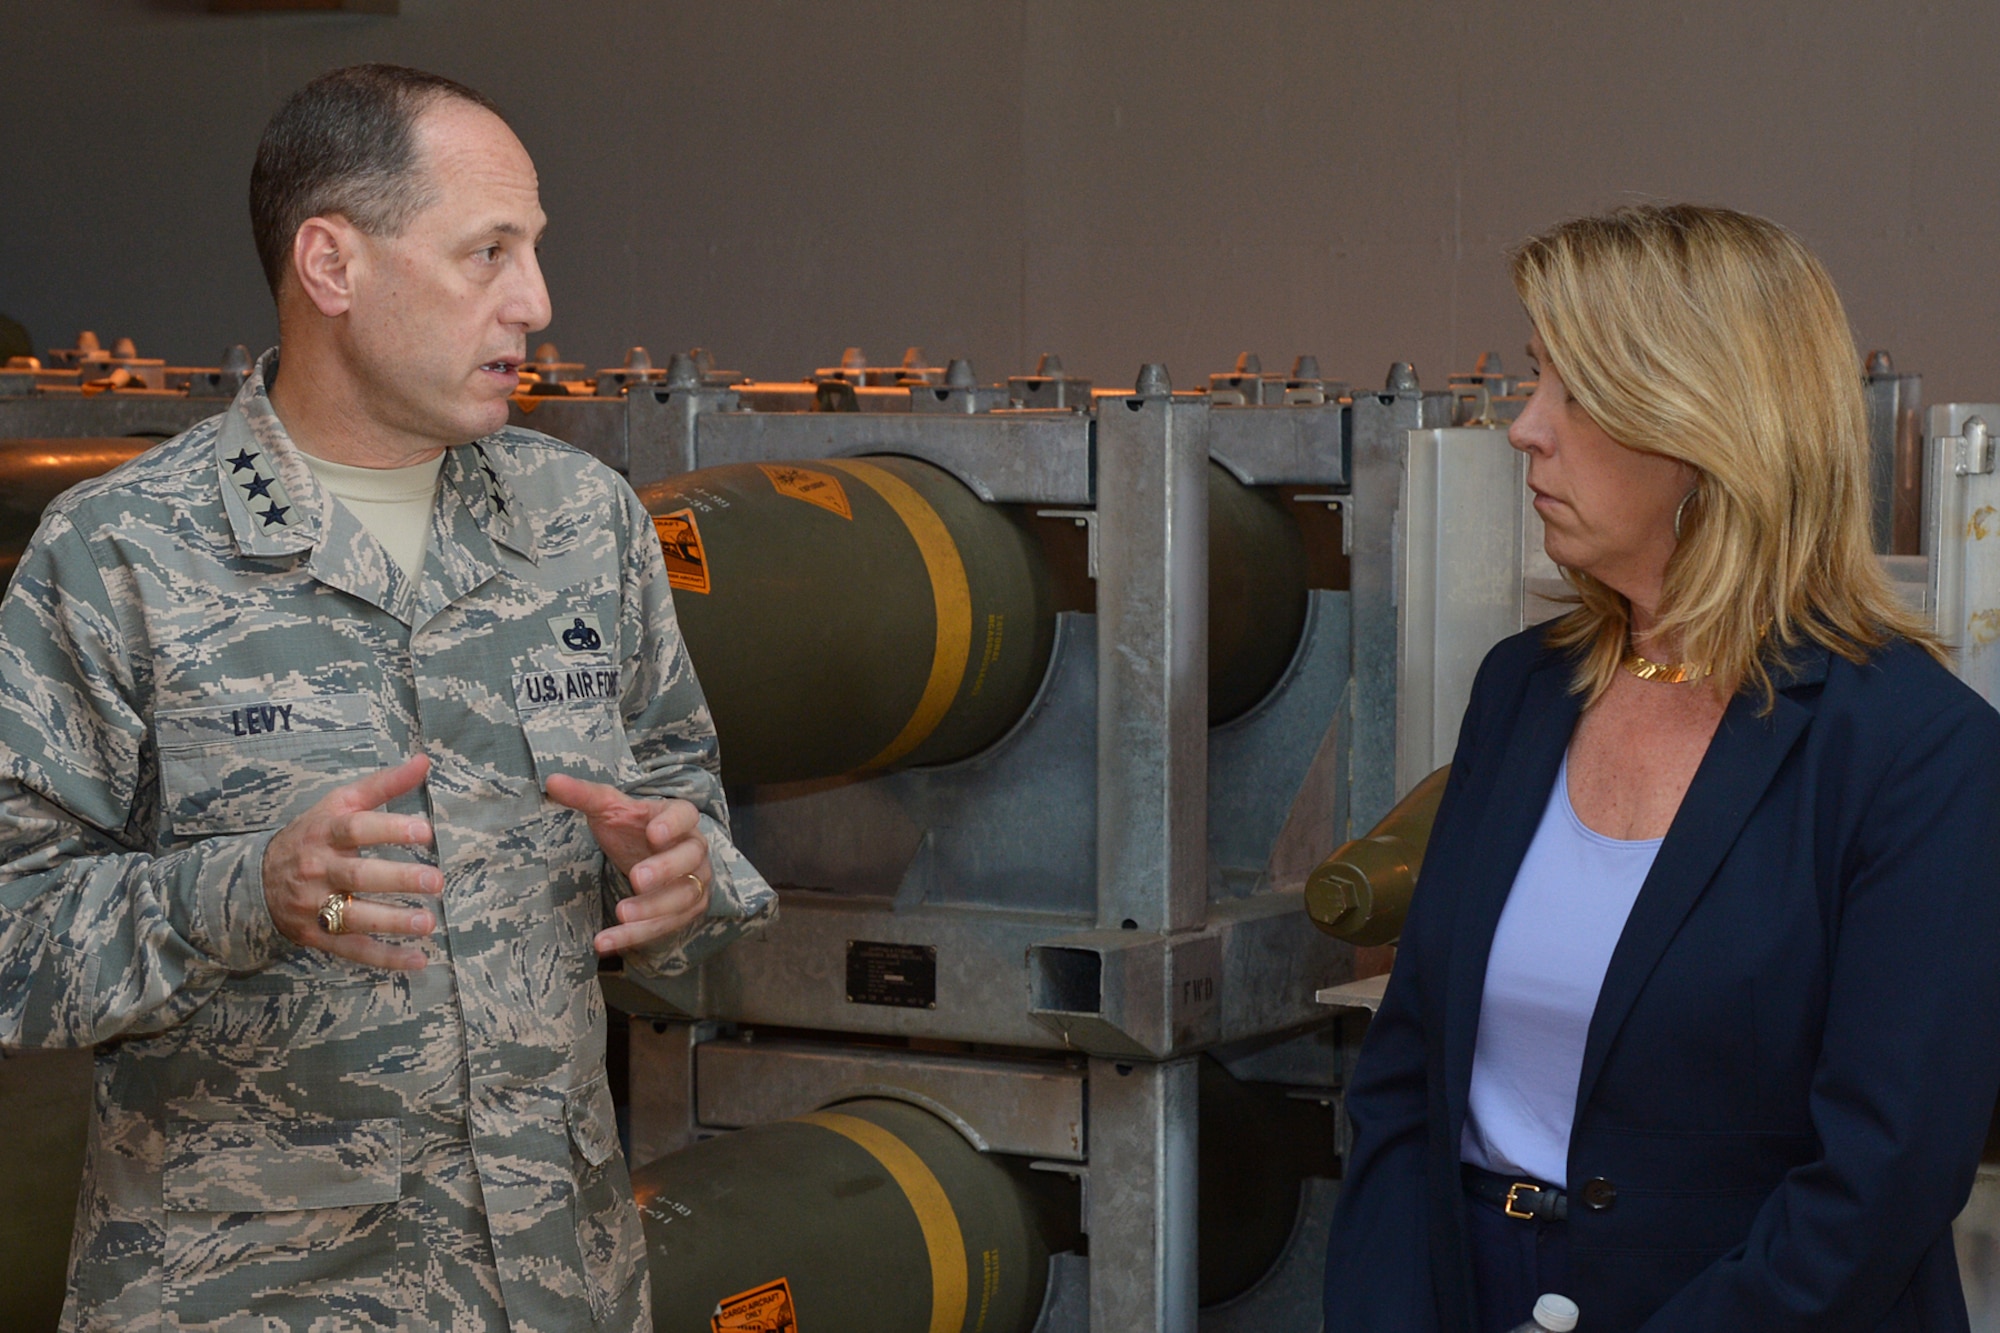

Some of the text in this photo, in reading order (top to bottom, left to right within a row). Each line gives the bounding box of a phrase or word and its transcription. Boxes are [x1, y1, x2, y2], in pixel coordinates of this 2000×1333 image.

[526, 675, 564, 703] U.S.
[567, 671, 597, 699] AIR
[232, 704, 293, 736] LEVY
[1183, 977, 1213, 1004] FWD
[722, 1292, 779, 1320] CARGO AIRCRAFT
[745, 1309, 762, 1321] ONLY
